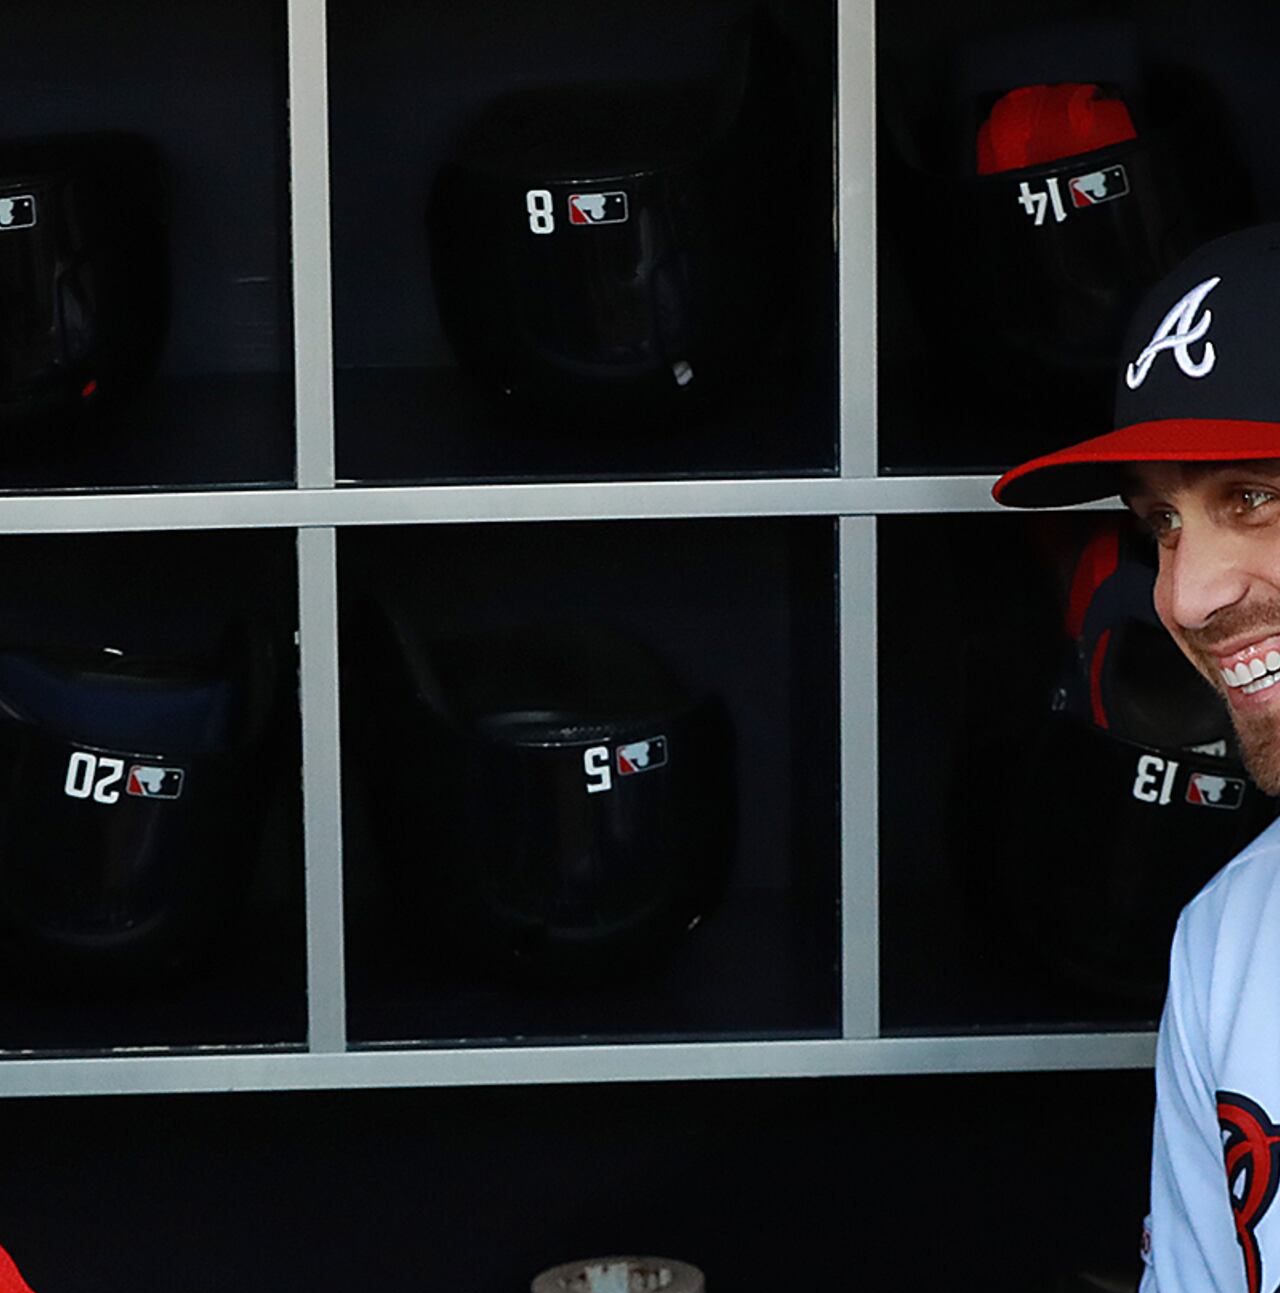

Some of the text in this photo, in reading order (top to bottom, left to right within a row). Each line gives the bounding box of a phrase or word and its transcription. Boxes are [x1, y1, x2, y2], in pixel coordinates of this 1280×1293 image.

[526, 189, 555, 235] 8
[1018, 177, 1067, 226] 14
[1125, 276, 1221, 390] A
[64, 751, 125, 804] 20
[583, 745, 612, 793] 5
[1133, 754, 1179, 806] 13
